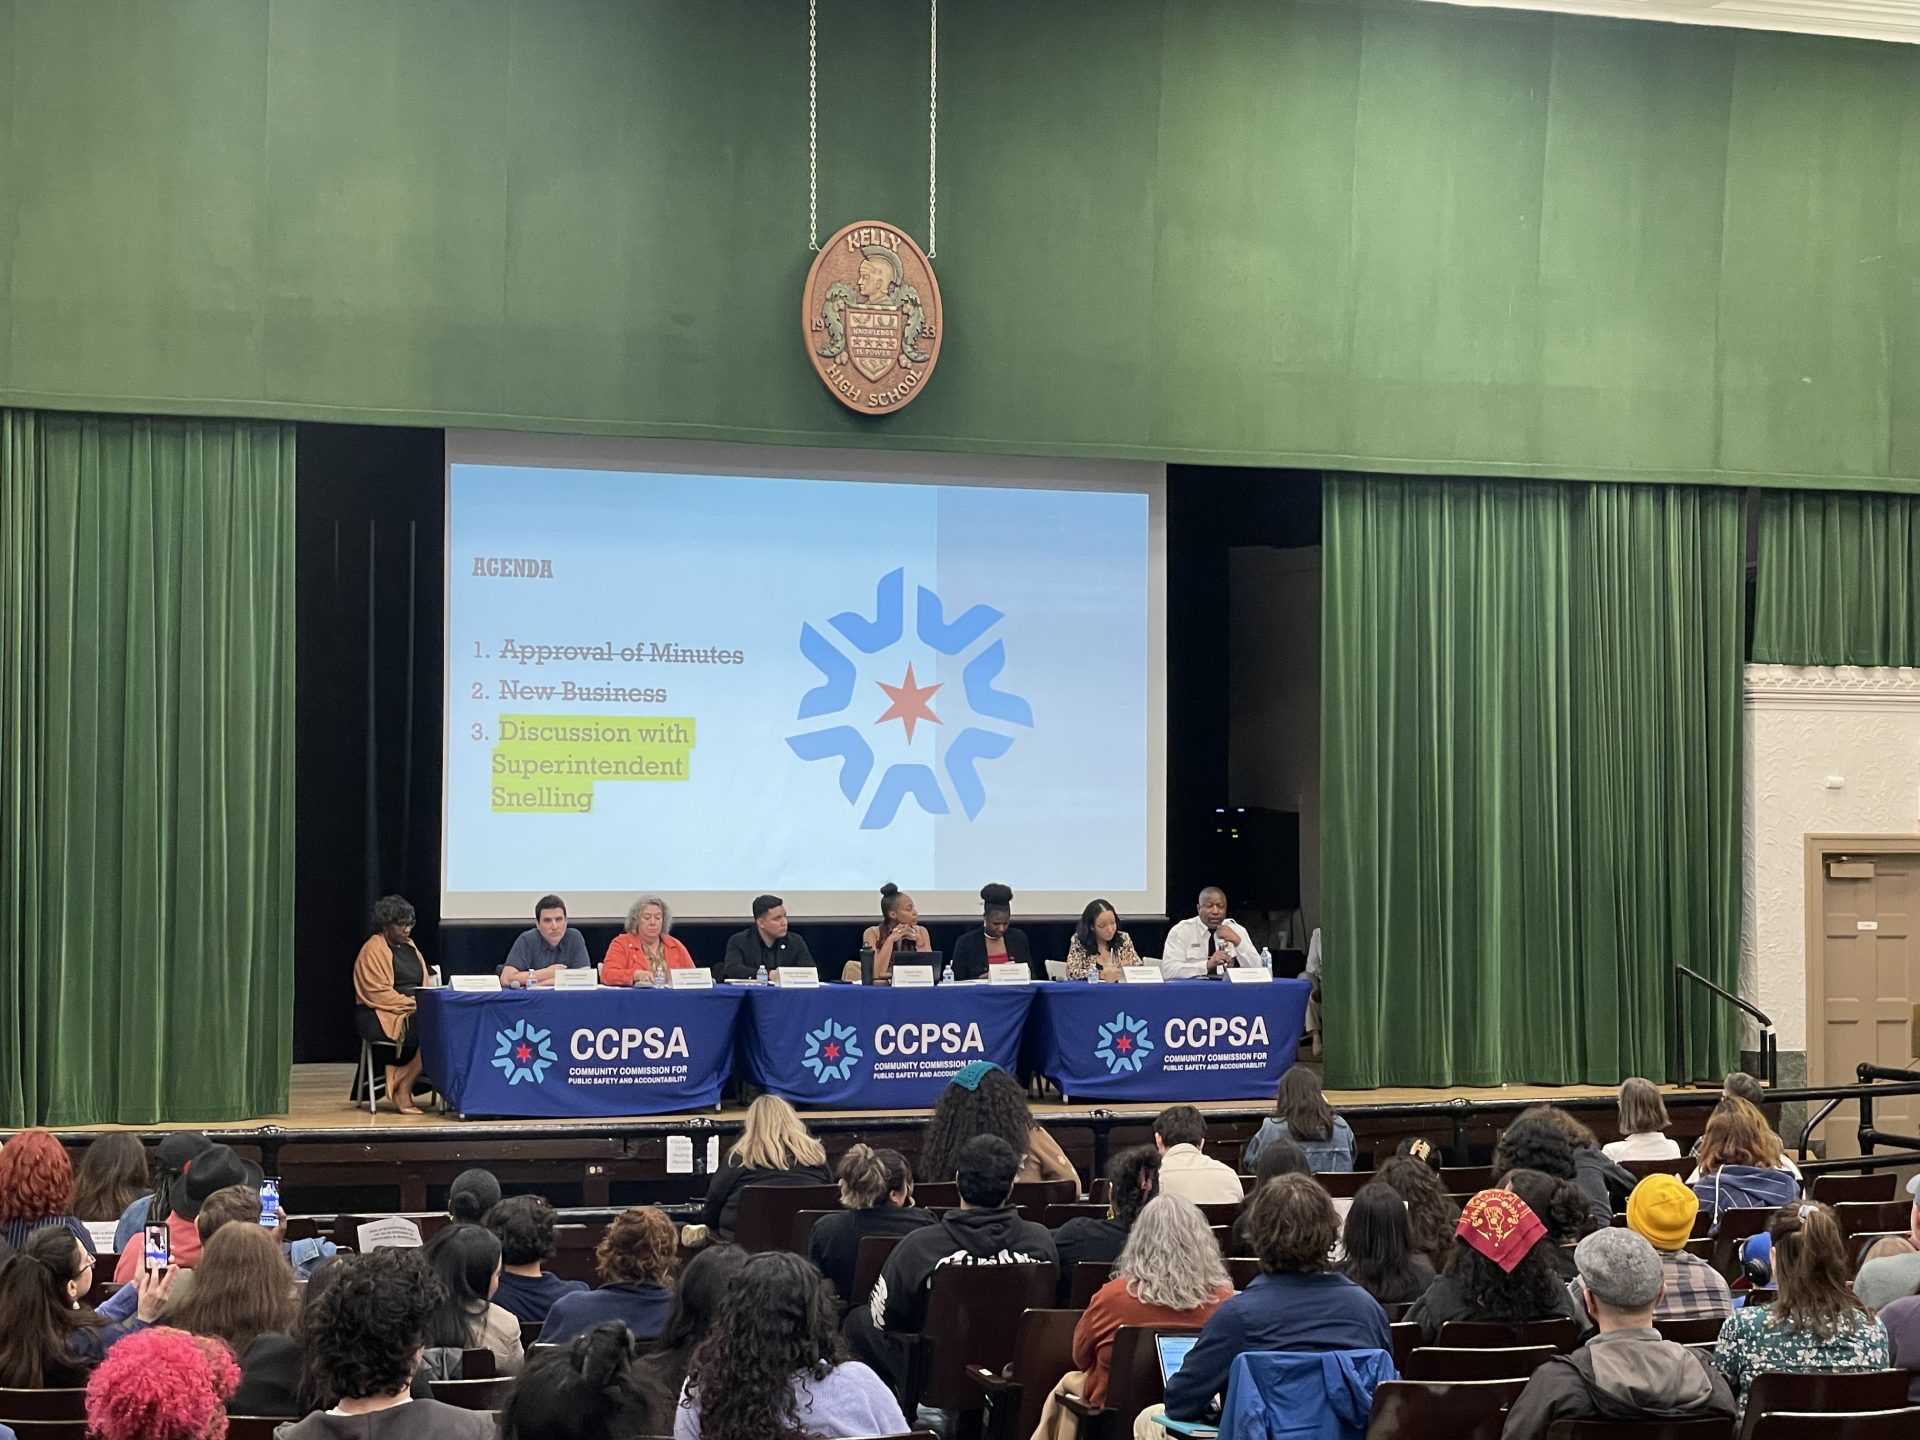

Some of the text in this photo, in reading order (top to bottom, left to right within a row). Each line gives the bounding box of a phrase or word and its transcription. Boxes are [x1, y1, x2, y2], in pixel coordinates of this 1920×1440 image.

[847, 227, 901, 253] KELLY
[811, 319, 825, 331] 19
[825, 363, 923, 407] HIGH SCHOOL
[472, 557, 554, 578] AGENDA
[474, 639, 744, 665] 1. Approval of Minutes
[471, 679, 667, 702] 2. New Business
[471, 720, 689, 743] 3. Discussion with
[492, 753, 683, 780] Superintendent
[492, 786, 593, 812] Snelling
[570, 1026, 690, 1060] CCPSA
[875, 1022, 985, 1055] CCPSA
[1164, 1016, 1270, 1049] CCPSA
[874, 1061, 918, 1070] COMMUNITY
[920, 1060, 967, 1069] COMMISSION
[1164, 1052, 1268, 1063] COMMUNITY COMMISSION FOR
[568, 1075, 687, 1085] PUBLIC SAFETY AND ACCOUNTABILITY
[569, 1065, 687, 1075] COMMUNITY COMMISSION FOR
[895, 1071, 918, 1079] SAFETY
[920, 1070, 932, 1078] AND
[933, 1070, 960, 1078] ACCOUN
